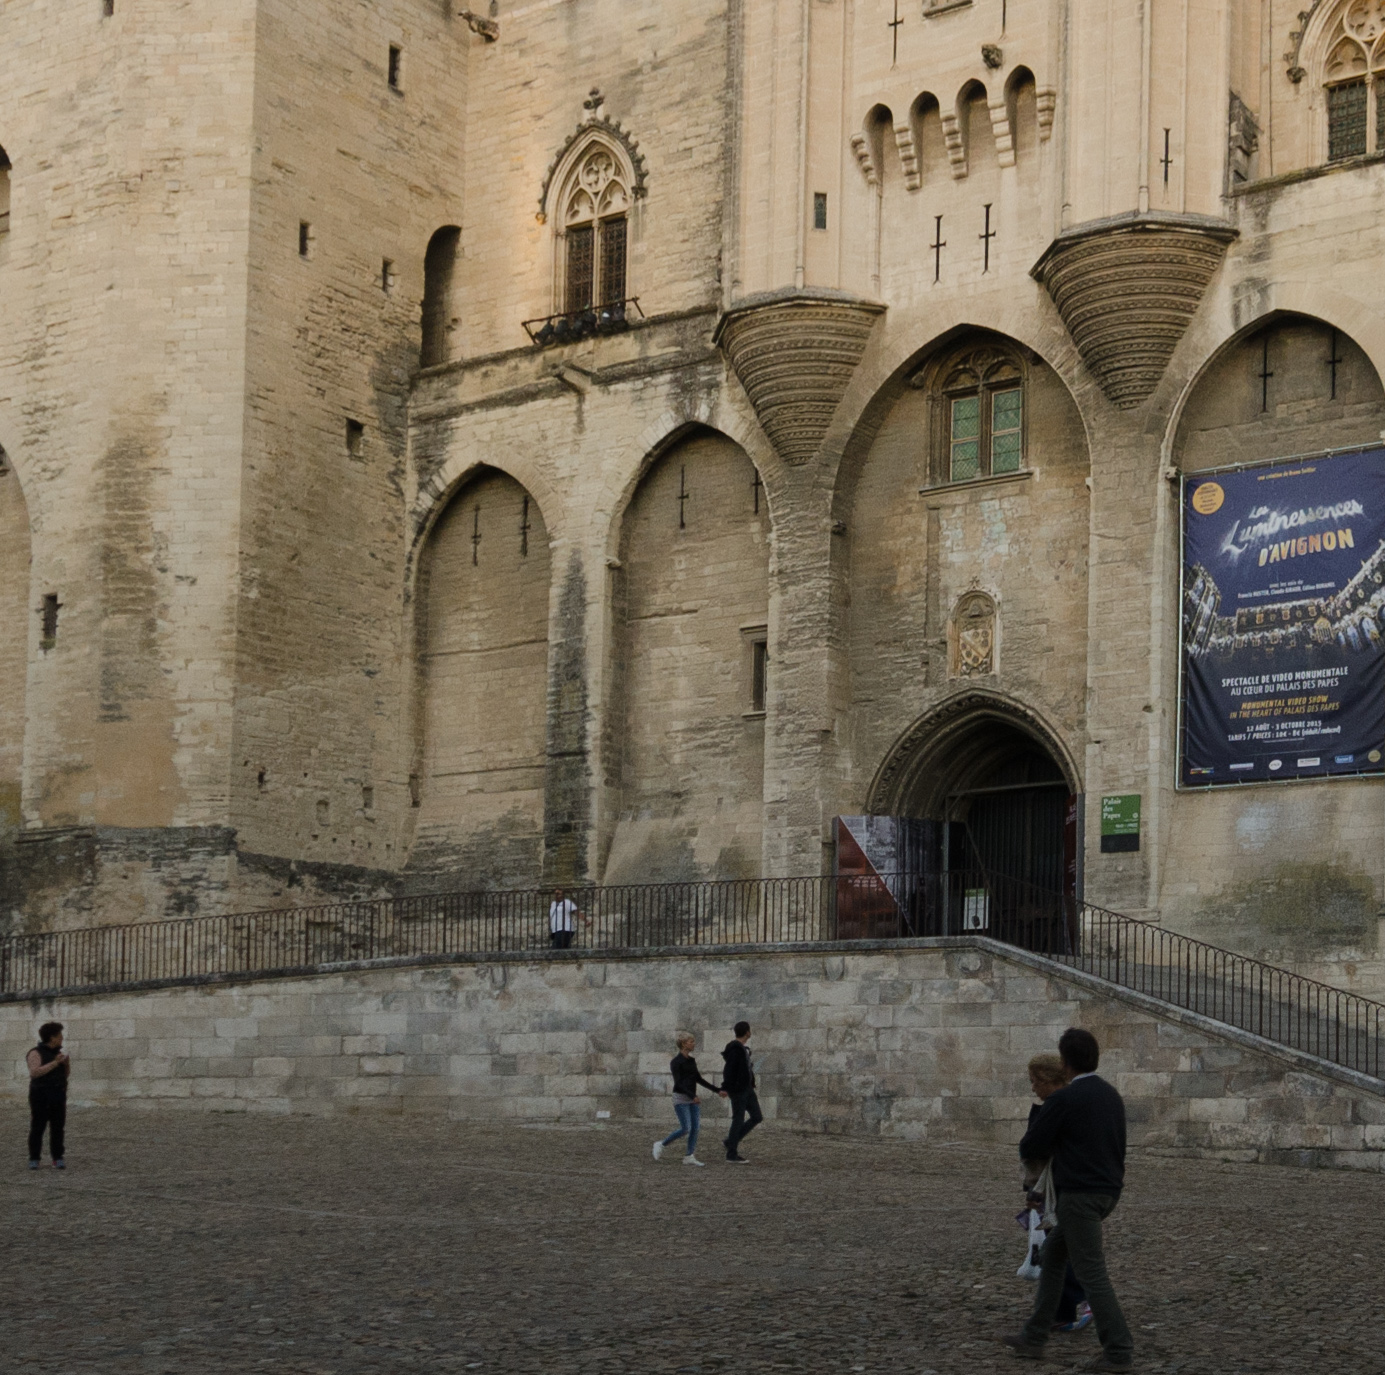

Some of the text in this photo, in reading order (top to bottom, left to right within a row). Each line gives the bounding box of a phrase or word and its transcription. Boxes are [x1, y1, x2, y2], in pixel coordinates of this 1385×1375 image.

[1248, 506, 1269, 519] Les
[1221, 499, 1363, 554] Luminessences
[1258, 528, 1354, 567] D'AVIGNON
[1222, 666, 1348, 687] SPECTACLE DE VIDEO MONUMENTALE
[1230, 687, 1241, 696] AU
[1265, 684, 1275, 693] DU
[1276, 682, 1301, 692] PALAIS
[1302, 680, 1315, 689] DES
[1317, 678, 1339, 688] PAPES
[1230, 702, 1340, 719] IN THE HEART OF PALAIS DES PAPES
[1241, 695, 1328, 710] MONUMENTAL VIDEO SHOW
[1281, 721, 1305, 730] OCTOBRE
[1228, 733, 1246, 741] TARIFS
